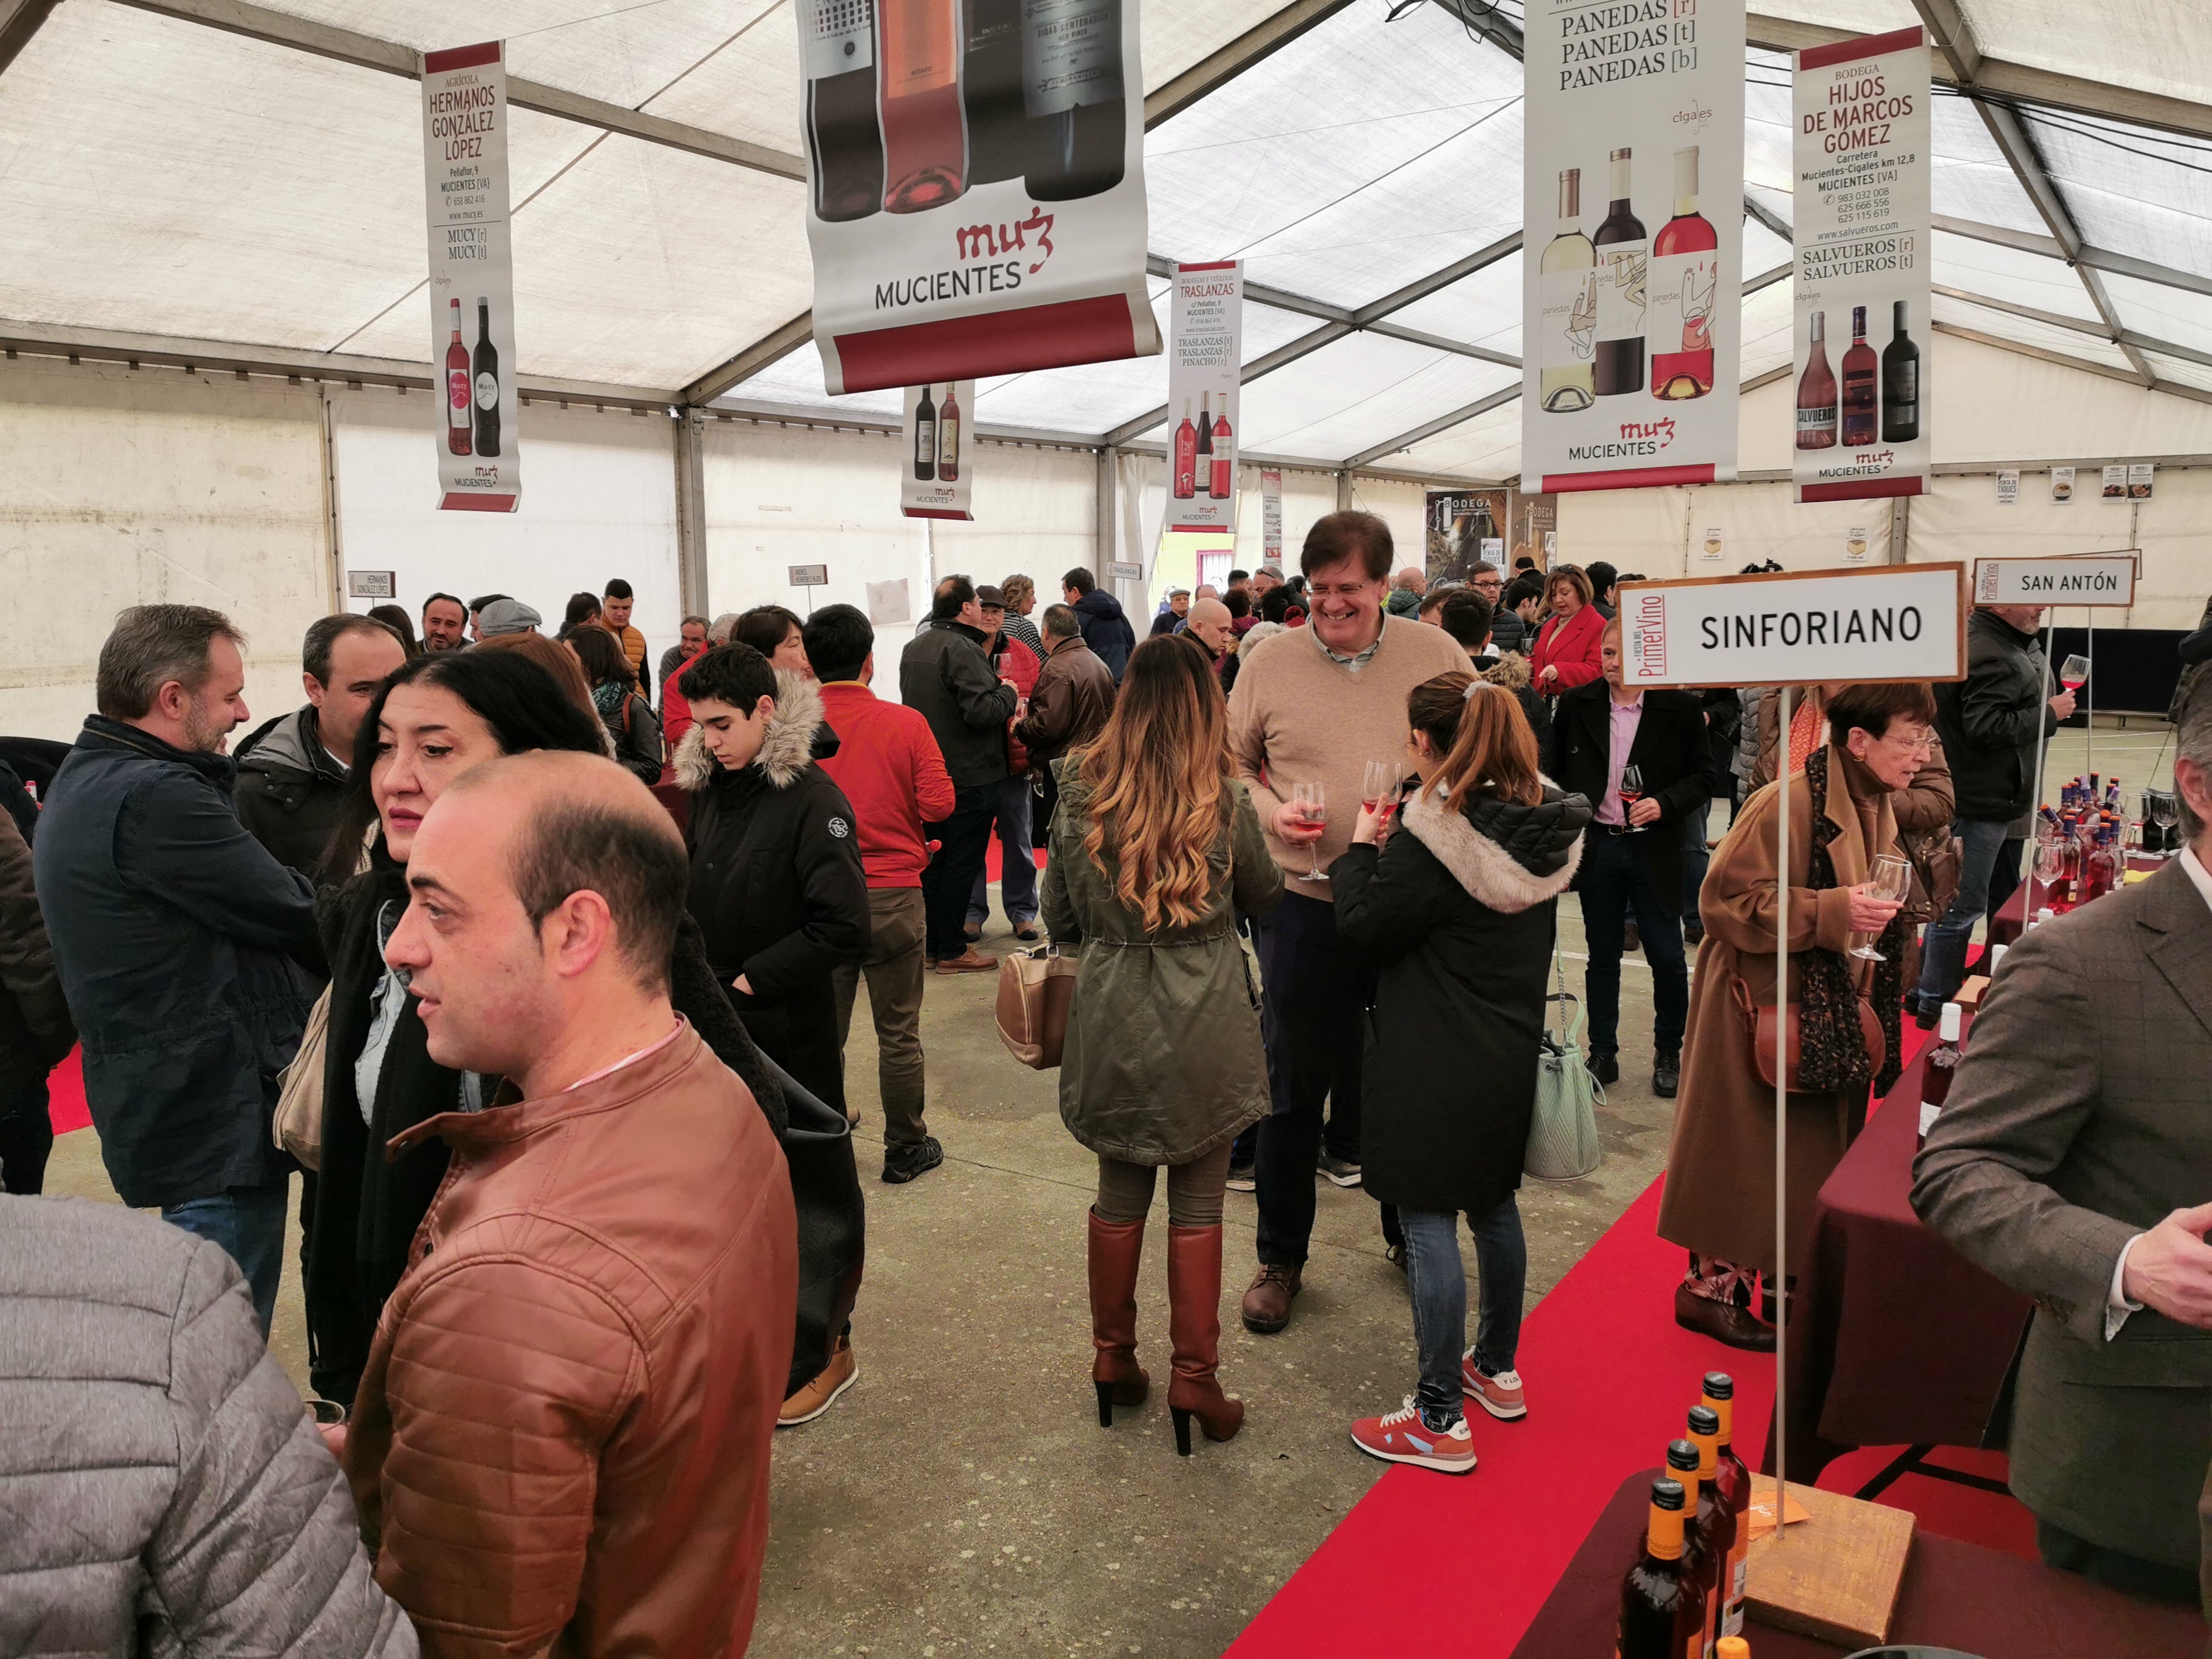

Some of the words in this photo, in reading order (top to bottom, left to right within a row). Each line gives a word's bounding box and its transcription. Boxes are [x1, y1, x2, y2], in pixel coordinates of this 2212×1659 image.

[1561, 0, 1667, 38] PANEDAS
[1562, 24, 1668, 64] PANEDAS
[1674, 19, 1695, 45] [t]
[1560, 52, 1665, 91] PANEDAS
[1672, 47, 1697, 73] [b]
[1835, 64, 1880, 81] BODEGA
[445, 73, 478, 88] AGRÍCOLA
[430, 85, 495, 114] HERMANOS
[1829, 76, 1885, 106] HIJOS
[432, 107, 494, 138] GONZÁLEZ
[1803, 111, 1827, 135] DE
[1833, 95, 1913, 129] MARCOS
[1824, 123, 1891, 153] GÓMEZ
[445, 133, 482, 161] LÓPEZ
[1837, 150, 1879, 164] Carretera
[475, 166, 478, 175] 9
[1801, 161, 1879, 181] Mucientes-Cigales
[1882, 158, 1895, 167] km
[1897, 154, 1915, 166] 12,8
[441, 181, 476, 193] MUCIENTES
[1818, 173, 1874, 192] MUCIENTES
[1877, 169, 1897, 184] [VA]
[454, 196, 463, 206] 658
[464, 195, 474, 205] 862
[475, 194, 485, 204] 416
[1838, 193, 1854, 203] 983
[1855, 190, 1871, 200] 032
[1873, 187, 1889, 198] 008
[1838, 203, 1854, 213] 625
[1855, 200, 1871, 210] 666
[1874, 197, 1889, 207] 556
[1838, 213, 1854, 224] 625
[1857, 210, 1871, 221] 115
[1874, 207, 1889, 218] 619
[447, 228, 476, 243] MUCY
[1818, 221, 1899, 240] www.salvueros.com
[448, 245, 477, 260] MUCY
[1803, 239, 1895, 264] SALVUEROS
[1803, 256, 1897, 281] SALVUEROS
[876, 261, 1021, 310] MUCIENTES
[1180, 283, 1234, 298] TRASLANZAS
[1178, 337, 1223, 347] TRASLANZAS
[1178, 347, 1222, 357] TRASLANZAS
[1182, 357, 1217, 367] PINACHO
[1798, 407, 1835, 423] SALVUEROS
[1569, 441, 1656, 460] MUCIENTES
[1819, 465, 1881, 478] MUCIENTES
[454, 478, 493, 488] MUCIENTES
[916, 495, 948, 504] MUCIENTES
[1445, 498, 1491, 508] BODEGA
[2021, 575, 2054, 591] SAN
[2060, 571, 2117, 591] ANTÓN
[1701, 606, 1922, 650] SINFORIANO
